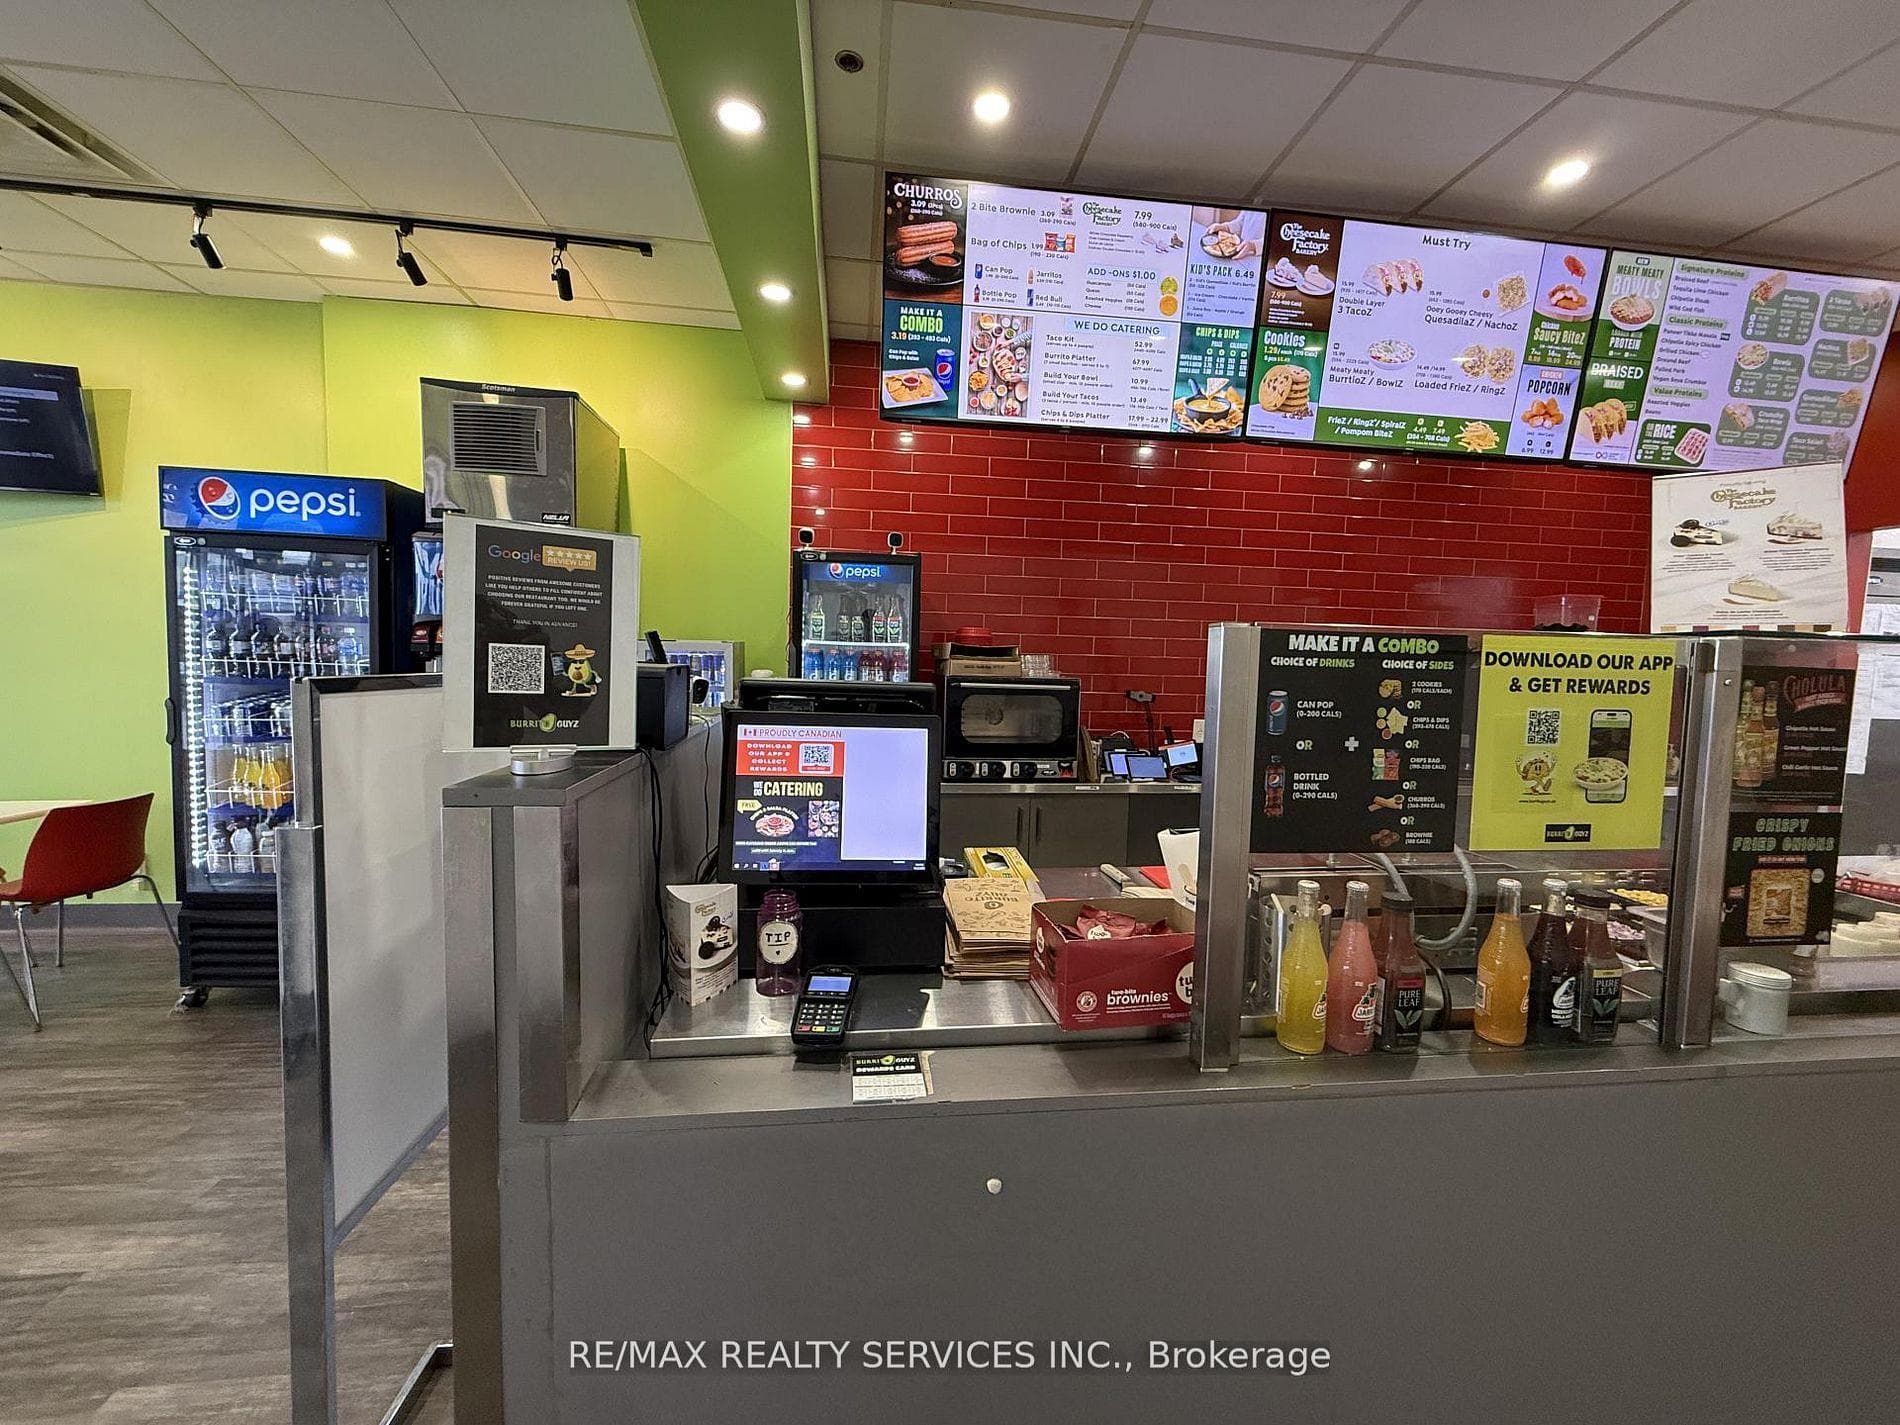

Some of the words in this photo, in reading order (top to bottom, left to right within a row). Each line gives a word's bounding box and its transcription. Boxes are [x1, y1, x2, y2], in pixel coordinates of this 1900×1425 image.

[894, 183, 962, 209] CHURROS
[911, 200, 926, 208] 3.09
[980, 204, 997, 212] Bite
[1000, 205, 1036, 216] Brownie
[1134, 211, 1153, 220] 7.99
[1280, 223, 1331, 240] Cheesecake
[971, 238, 988, 249] Bag
[990, 240, 1000, 248] of
[1002, 241, 1027, 251] Chips
[1292, 238, 1329, 253] Factory
[1423, 235, 1450, 248] Must
[1453, 239, 1471, 250] Try
[1000, 267, 1013, 275] Pop
[1087, 268, 1106, 276] ADD
[1133, 270, 1156, 280] $1.00
[1190, 263, 1211, 276] KID'S
[1212, 265, 1232, 278] PACK
[1235, 269, 1255, 279] 6.49
[1617, 265, 1640, 276] MEATY
[1641, 267, 1664, 279] MEATY
[1612, 276, 1662, 300] BOWLS
[982, 289, 1003, 298] Bottle
[1004, 291, 1018, 301] Pop
[1340, 297, 1364, 306] Double
[1366, 298, 1385, 308] Layer
[900, 307, 925, 315] MAKE
[936, 309, 943, 317] A
[1338, 306, 1343, 314] 3
[1346, 307, 1372, 316] TacoZ
[1426, 306, 1444, 315] Ooey
[1446, 308, 1467, 316] Gooey
[1469, 309, 1493, 318] Cheesy
[900, 315, 943, 334] COMBO
[1484, 320, 1518, 331] NachoZ
[1669, 317, 1693, 325] Classic
[1074, 321, 1090, 330] WE
[1093, 322, 1108, 331] DO
[1110, 323, 1160, 335] CATERING
[1195, 326, 1216, 338] CHIPS
[1217, 328, 1223, 337] &
[1224, 328, 1240, 340] DIPS
[891, 332, 907, 341] 3.19
[1064, 335, 1074, 343] Kit
[1264, 331, 1306, 347] Cookies
[1534, 327, 1561, 342] Saucy
[1562, 331, 1586, 345] BiteZ
[1609, 337, 1641, 350] PROTEIN
[1044, 352, 1070, 361] Burrito
[1072, 354, 1097, 362] Platter
[1330, 366, 1350, 375] Meaty
[1353, 367, 1374, 376] Meaty
[1591, 363, 1644, 380] BRAISED
[1044, 372, 1062, 380] Build
[1064, 373, 1080, 381] Your
[1081, 374, 1099, 382] Bowl
[1131, 377, 1149, 385] 10.99
[1376, 379, 1403, 388] BowlZ
[1415, 380, 1447, 390] Loaded
[1450, 382, 1471, 391] FrieZ
[1481, 386, 1506, 395] RingZ
[1528, 379, 1572, 395] POPCORN
[1042, 391, 1061, 399] Build
[1063, 392, 1078, 400] Your
[1079, 393, 1099, 401] Tacos
[1130, 396, 1147, 404] 13.49
[1041, 409, 1060, 419] Chips
[1069, 411, 1083, 420] Dips
[1084, 412, 1110, 421] Platter
[1128, 415, 1145, 423] 17.99
[1328, 417, 1346, 425] FrieZ
[1381, 420, 1406, 429] SpiralZ
[1341, 427, 1373, 436] Pompom
[1375, 429, 1393, 438] BiteZ
[1653, 424, 1677, 438] RICE
[249, 487, 356, 521] pepsi
[488, 545, 541, 563] Google
[548, 557, 577, 566] REVIEW
[845, 567, 881, 578] pepsi
[1289, 634, 1340, 652] MAKE
[1342, 636, 1360, 652] IT
[1362, 637, 1375, 652] A
[1378, 637, 1439, 654] COMBO
[1271, 656, 1304, 666] CHOICE
[1306, 657, 1319, 667] OF
[1319, 657, 1355, 668] DRINKS
[1382, 659, 1414, 669] CHOICE
[1416, 660, 1428, 670] OF
[1429, 660, 1454, 670] SIDES
[1485, 651, 1593, 669] DOWNLOAD
[1597, 654, 1634, 670] OUR
[1638, 655, 1674, 671] APP
[1509, 677, 1522, 693] &
[1527, 677, 1562, 693] GET
[1566, 679, 1651, 695] REWARDS
[1297, 701, 1315, 709] CAN
[1317, 701, 1334, 709] POP
[1407, 700, 1422, 710] OR
[1296, 710, 1320, 718] (0-200
[1320, 710, 1342, 719] CALS)
[556, 719, 579, 728] GUYZ
[760, 728, 797, 737] PROUDLY
[799, 729, 842, 738] CANADIAN
[1293, 773, 1330, 781] BOTTLED
[763, 781, 824, 797] CATERING
[1293, 782, 1320, 791] DRINK
[1292, 791, 1316, 800] (0-290
[1316, 791, 1338, 800] CALS)
[1756, 818, 1809, 832] CRISPY
[1732, 837, 1776, 851] FRIED
[1782, 837, 1835, 851] ONIONS
[765, 932, 791, 943] TIP
[1107, 991, 1169, 1006] brownies
[1400, 990, 1421, 998] PURE
[1398, 999, 1421, 1007] LEAF
